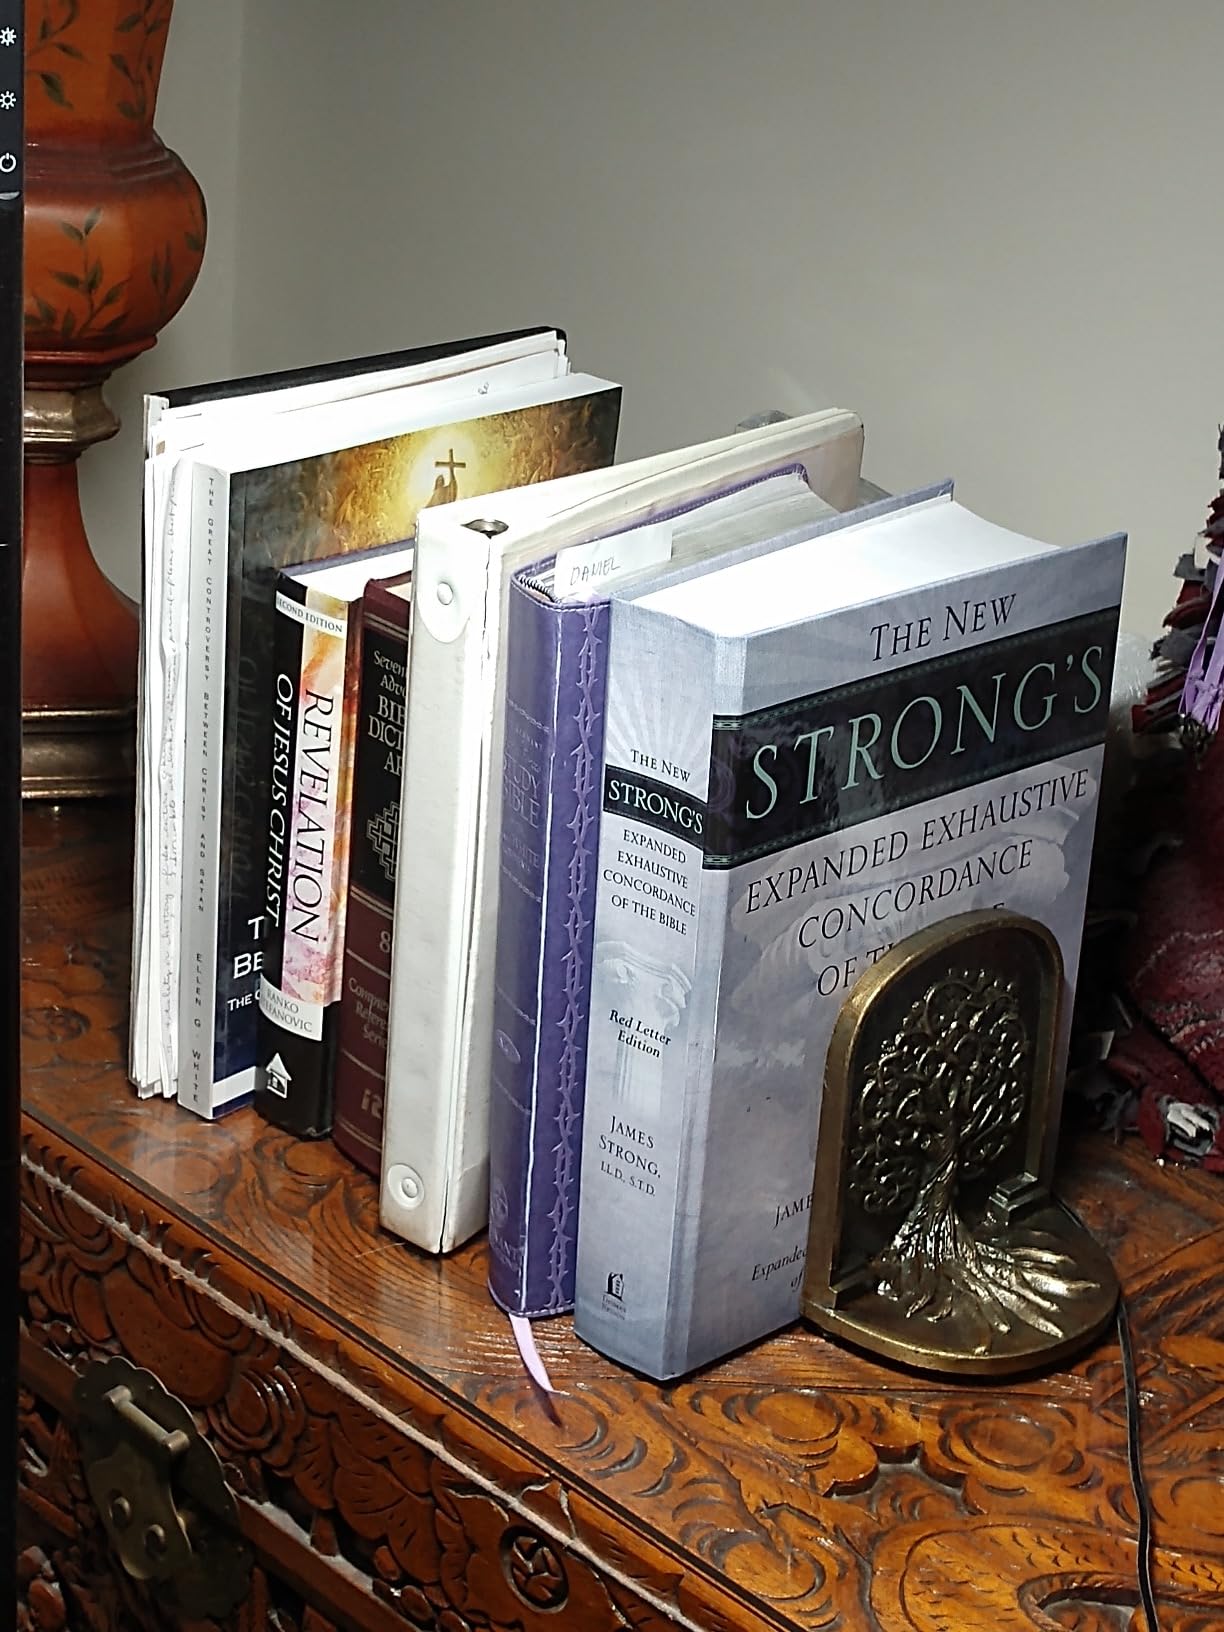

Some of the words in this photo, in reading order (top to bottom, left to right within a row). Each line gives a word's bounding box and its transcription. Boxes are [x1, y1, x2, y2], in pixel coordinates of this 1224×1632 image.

[569, 557, 621, 586] DANIEL
[204, 577, 213, 681] CONTROVERSY
[870, 620, 931, 662] THE
[943, 593, 1017, 641] NEW
[276, 673, 294, 720] OF
[746, 645, 1103, 819] STRONG'S
[271, 718, 291, 806] JESUS
[630, 748, 657, 770] THE
[661, 760, 691, 783] NEW
[200, 767, 208, 821] CHRIST
[290, 689, 335, 942] REVELATION
[608, 779, 703, 835] STRONG'S
[266, 808, 285, 927] CHRIST
[623, 829, 687, 864] EXPANDED
[746, 830, 908, 915] EXPANDED
[920, 769, 1089, 851] EXHAUSTIVE
[603, 869, 696, 918] CONCORDANCE
[617, 850, 688, 889] EXHAUSTIVE
[798, 840, 1034, 949] CONCORDANCE
[611, 894, 629, 910] OF
[632, 900, 656, 921] THE
[659, 911, 687, 936] BIBLE
[195, 953, 203, 1007] ELLEN
[233, 951, 264, 980] BE
[817, 957, 858, 997] OF
[866, 942, 894, 965] T
[227, 993, 253, 1012] THE
[609, 1009, 633, 1029] Red
[635, 1020, 672, 1046] Letter
[617, 1029, 661, 1059] Edition
[192, 1049, 201, 1103] WHITE
[610, 1115, 654, 1149] JAMES
